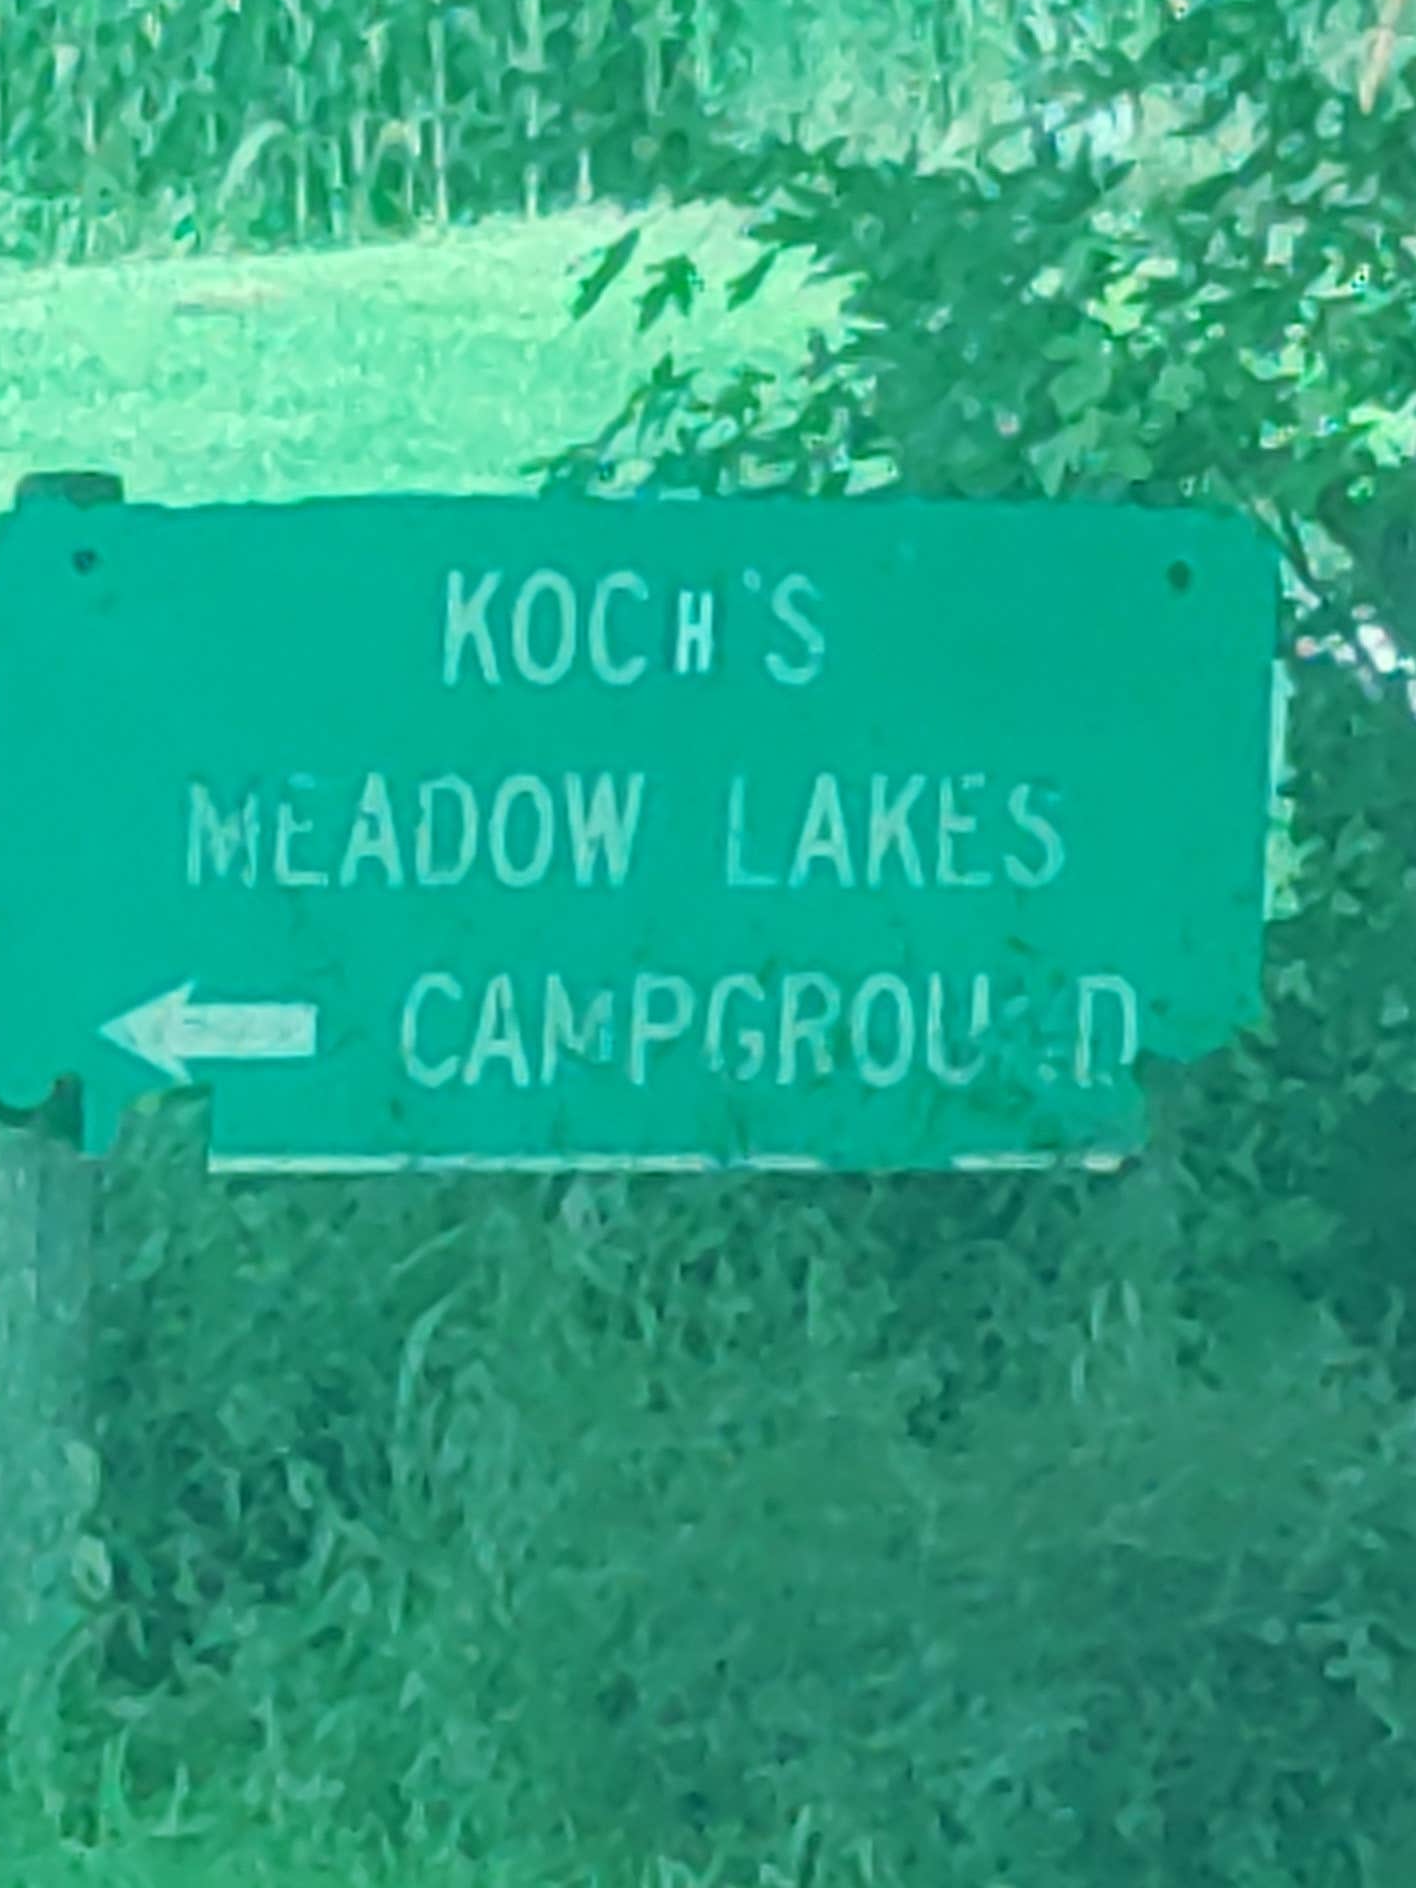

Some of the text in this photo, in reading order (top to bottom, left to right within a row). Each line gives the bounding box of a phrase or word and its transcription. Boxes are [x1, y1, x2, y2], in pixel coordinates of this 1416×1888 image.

[443, 568, 826, 686] KOCH'S
[186, 771, 1066, 889] MEADOW LAKES
[400, 971, 1138, 1089] CAMPGROUD
